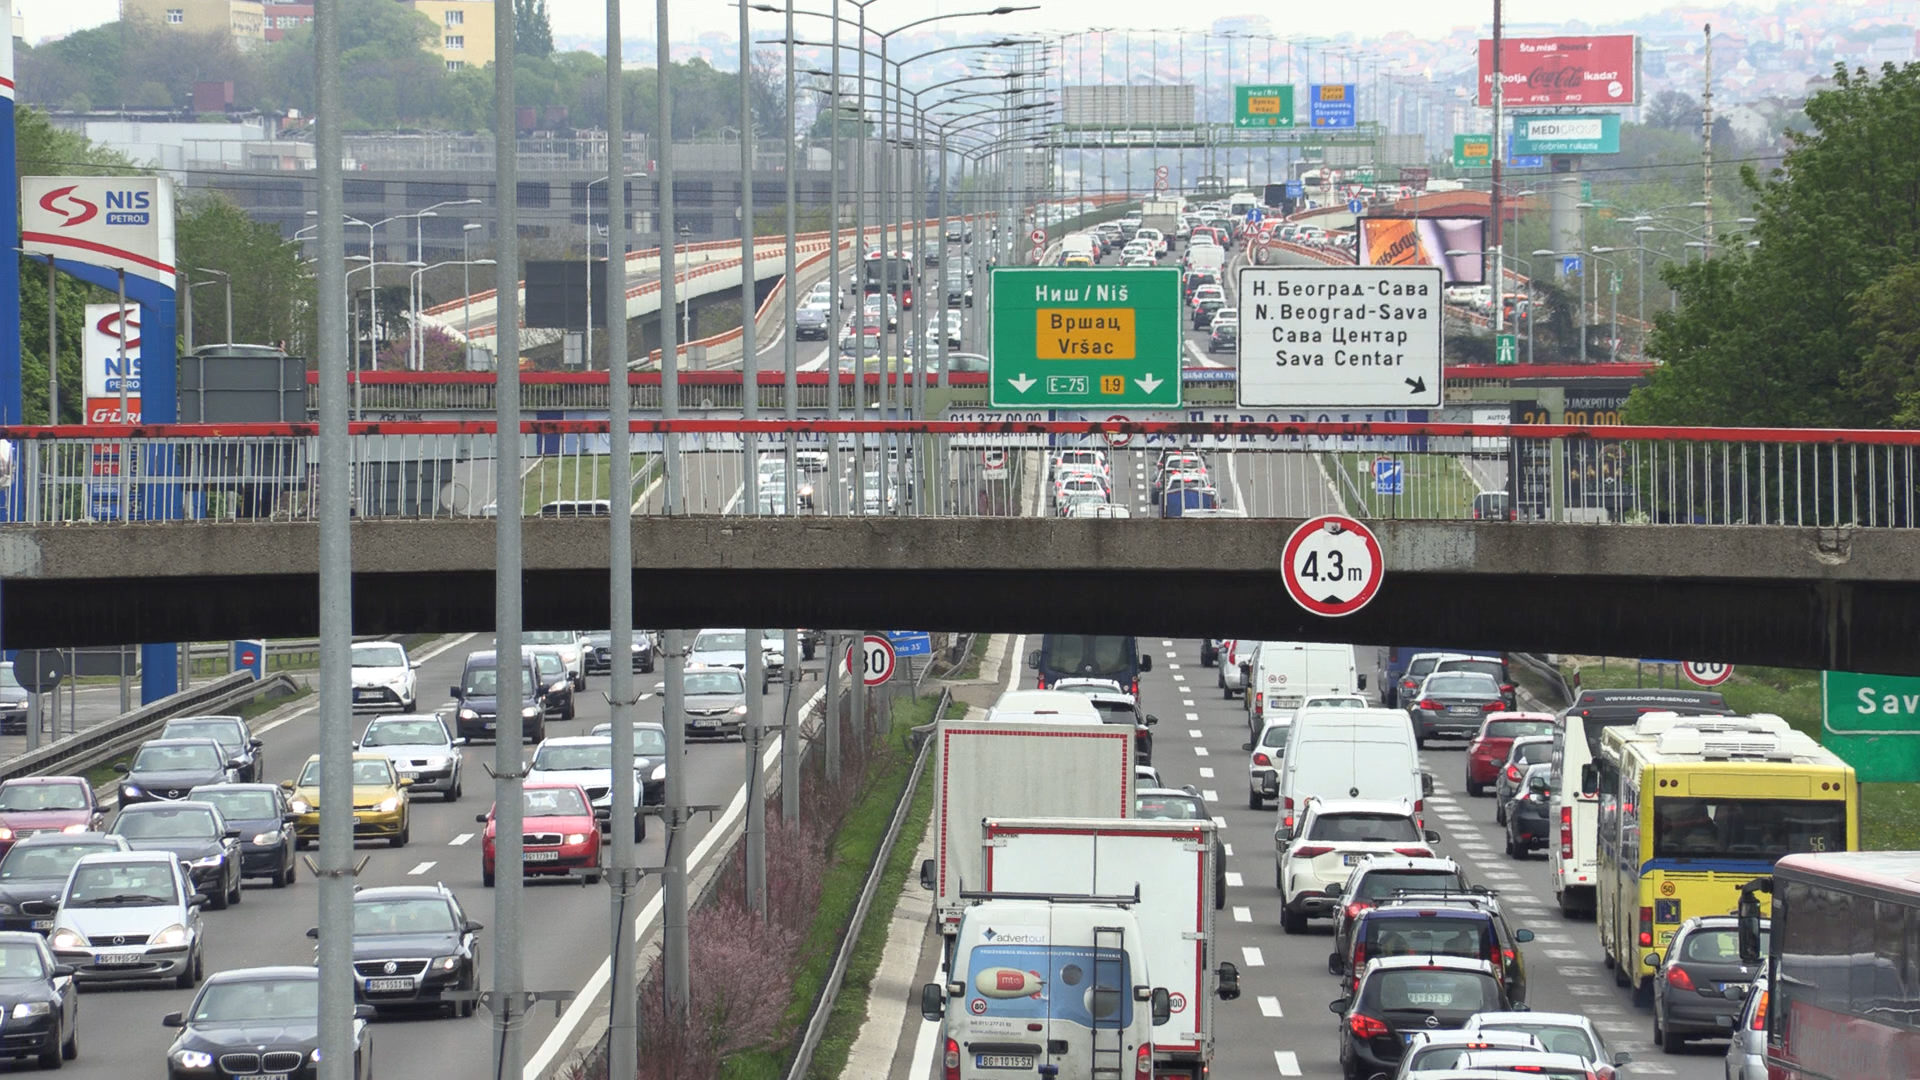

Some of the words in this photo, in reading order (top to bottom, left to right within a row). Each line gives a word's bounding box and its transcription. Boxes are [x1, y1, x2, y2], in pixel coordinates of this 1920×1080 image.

[1536, 43, 1557, 51] misli
[106, 191, 149, 209] NIS
[110, 214, 146, 223] PETROL
[1278, 280, 1429, 300] Београд-Сава
[1281, 304, 1428, 324] Beograd-Sava
[1051, 314, 1121, 333] Вршац
[1272, 326, 1323, 343] Сава
[1332, 327, 1408, 347] Центар
[1058, 338, 1115, 355] Vršac
[1276, 350, 1324, 366] Sava
[1334, 350, 1405, 366] Centar
[1050, 378, 1085, 392] E-75
[1571, 398, 1607, 409] JACKPOT
[1300, 550, 1344, 582] 4.3
[1347, 567, 1363, 582] m
[1663, 885, 1673, 893] 50
[996, 933, 1046, 944] advertout
[983, 1056, 994, 1066] BG
